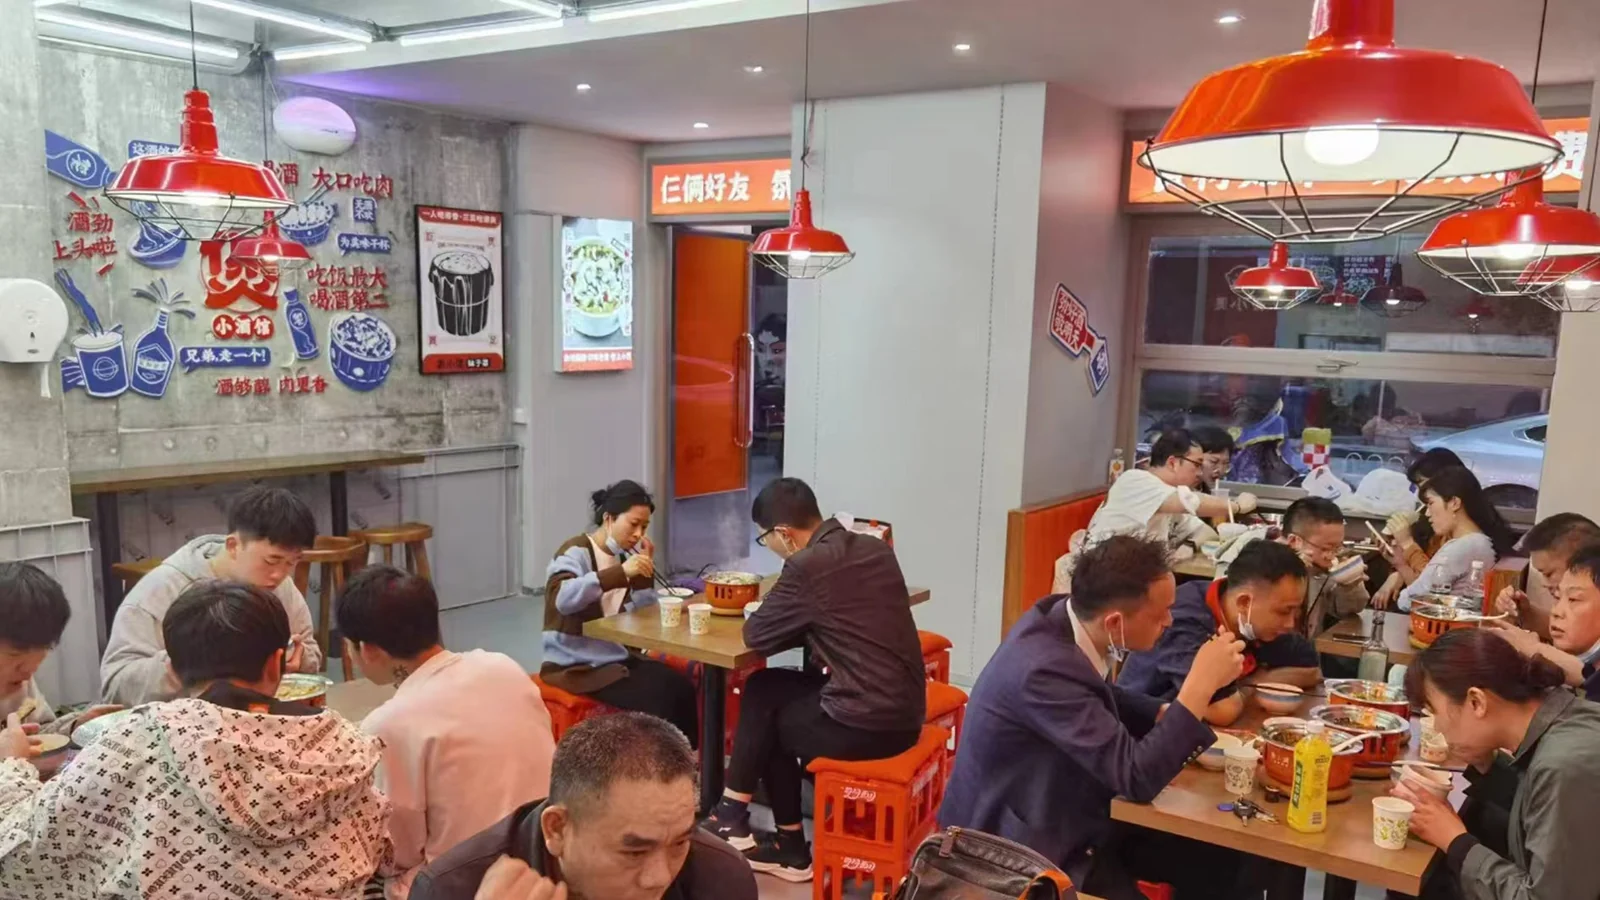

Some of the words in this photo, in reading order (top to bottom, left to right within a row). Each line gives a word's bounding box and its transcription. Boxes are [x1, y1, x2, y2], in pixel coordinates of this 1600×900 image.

[312, 166, 393, 199] 大口吃肉
[660, 170, 751, 204] 仨俩好友
[66, 211, 114, 233] 酒劲
[53, 236, 117, 260] 上头啦
[307, 264, 388, 289] 吃饭最大
[309, 288, 389, 311] 喝酒第二
[214, 316, 272, 336] 小酒馆
[279, 375, 328, 394] 肉更香
